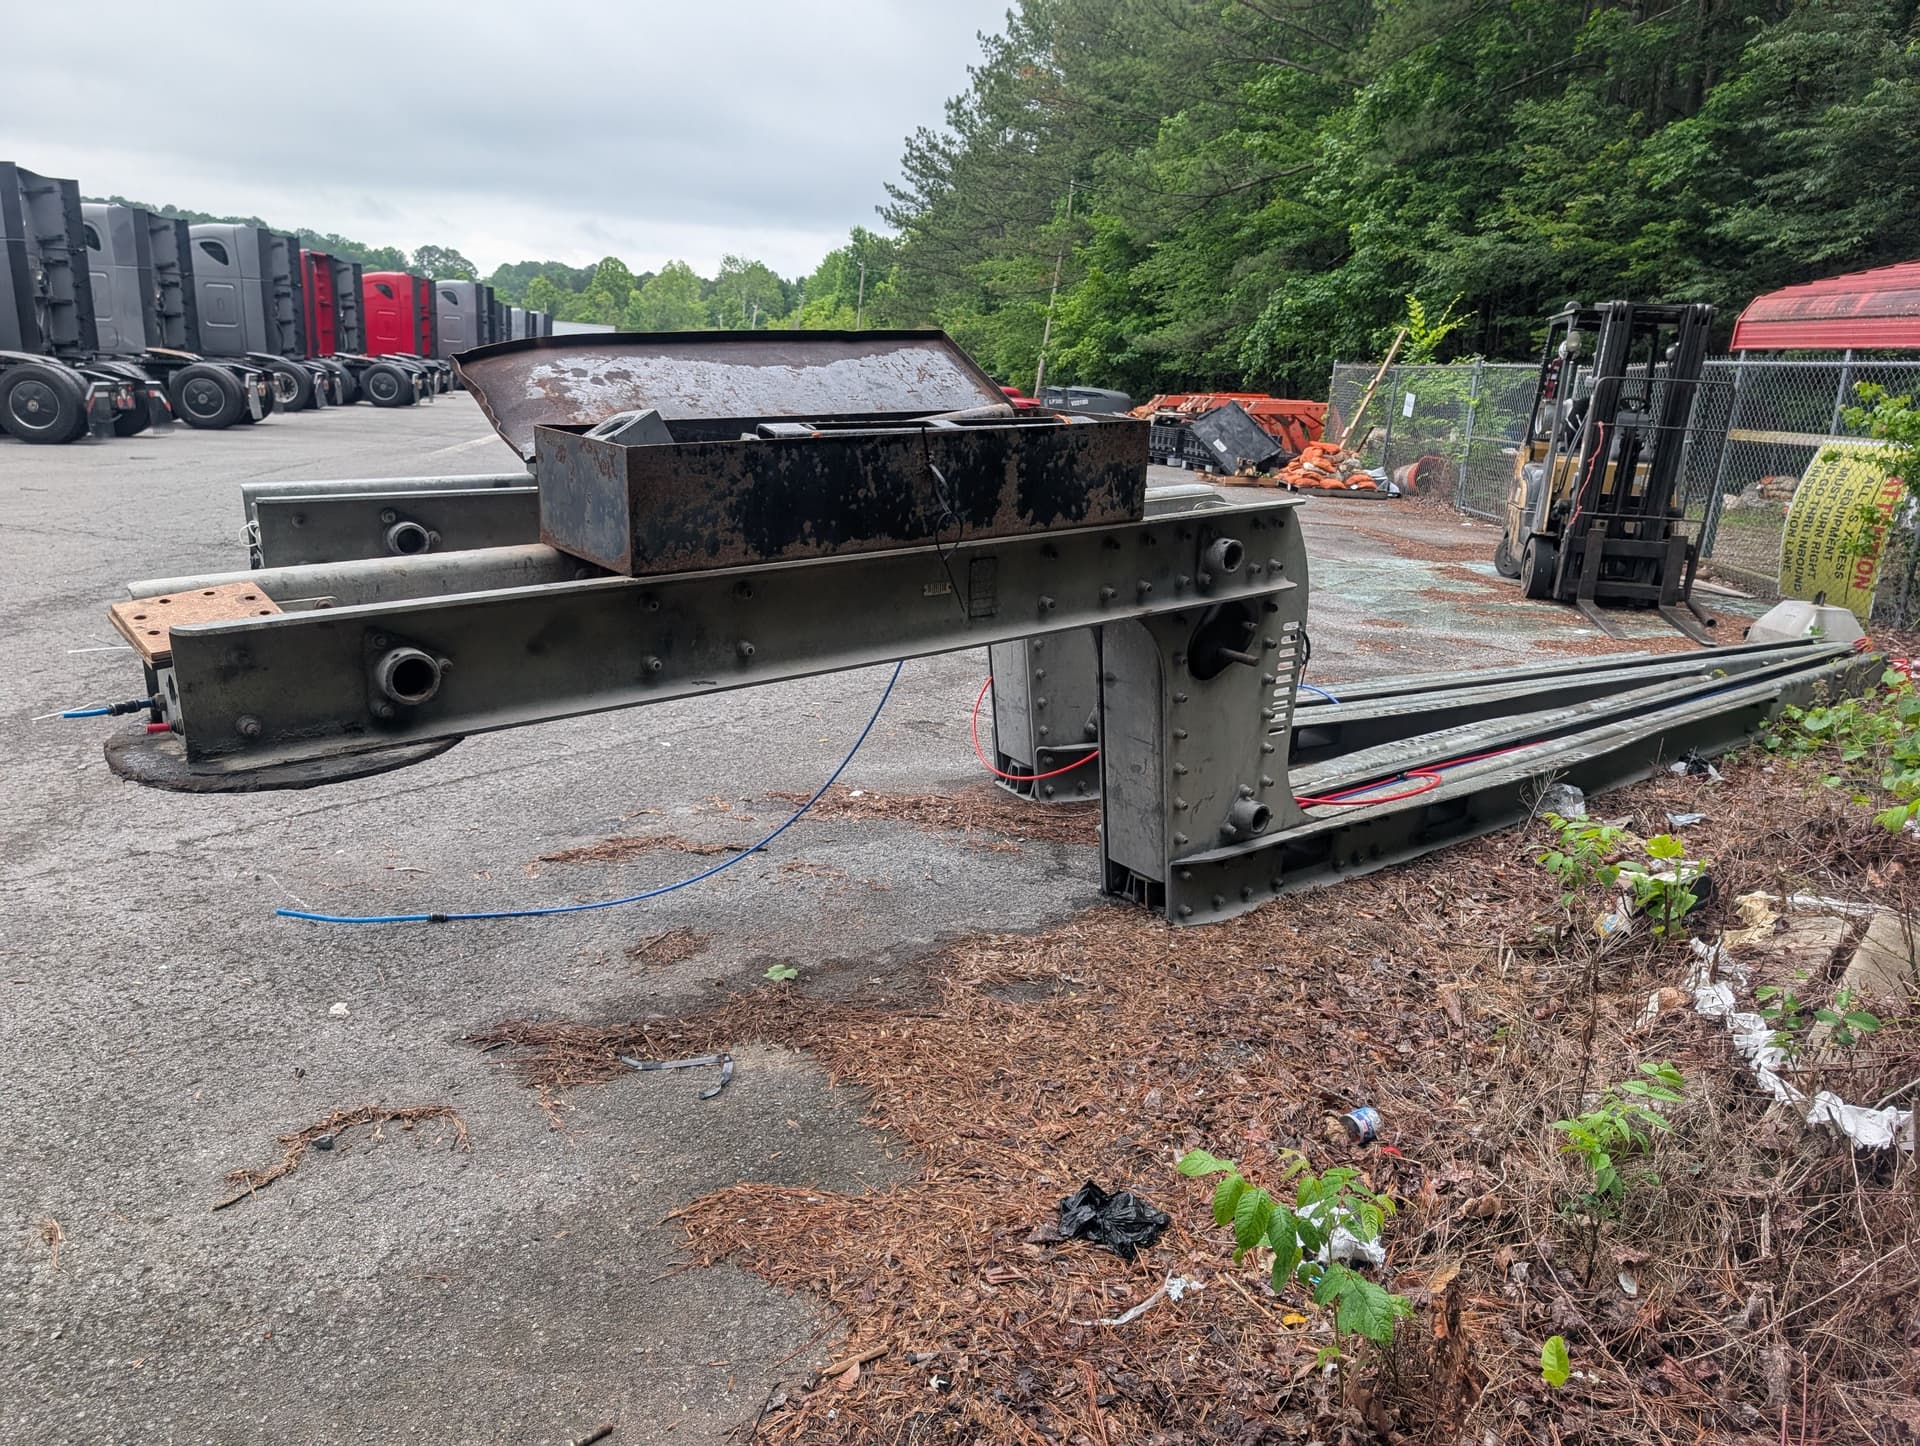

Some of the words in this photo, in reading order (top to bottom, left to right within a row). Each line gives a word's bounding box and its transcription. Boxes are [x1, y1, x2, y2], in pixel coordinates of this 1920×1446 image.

[1788, 466, 1822, 537] INSPECTION
[1815, 478, 1829, 496] GO
[1828, 467, 1850, 502] MUST
[1858, 476, 1875, 498] ALL
[1802, 501, 1820, 532] THRU
[1815, 504, 1833, 538] TURN
[1823, 489, 1855, 562] EQUIPMENT
[1783, 541, 1794, 572] LANE
[1794, 536, 1808, 592] INBOUND
[1808, 541, 1821, 580] RIGHT
